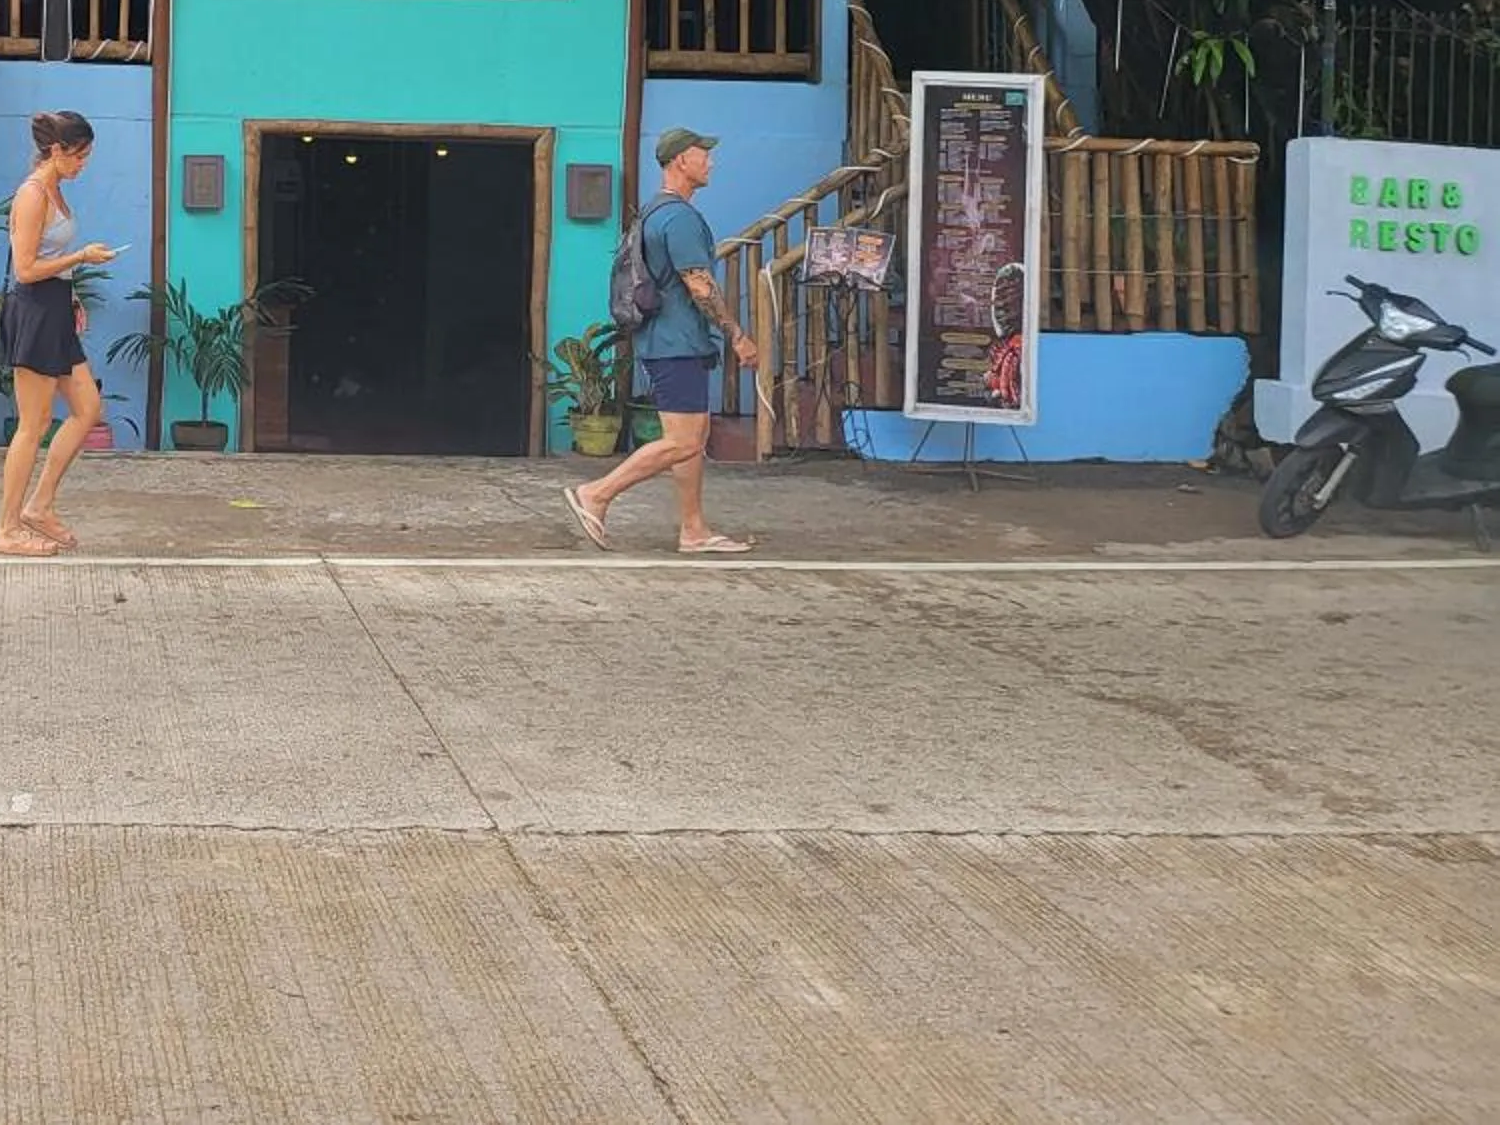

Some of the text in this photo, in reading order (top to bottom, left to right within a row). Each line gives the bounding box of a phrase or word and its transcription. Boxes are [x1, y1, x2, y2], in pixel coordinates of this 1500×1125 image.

[1350, 175, 1462, 210] BAR &
[1349, 218, 1481, 256] RESTO
